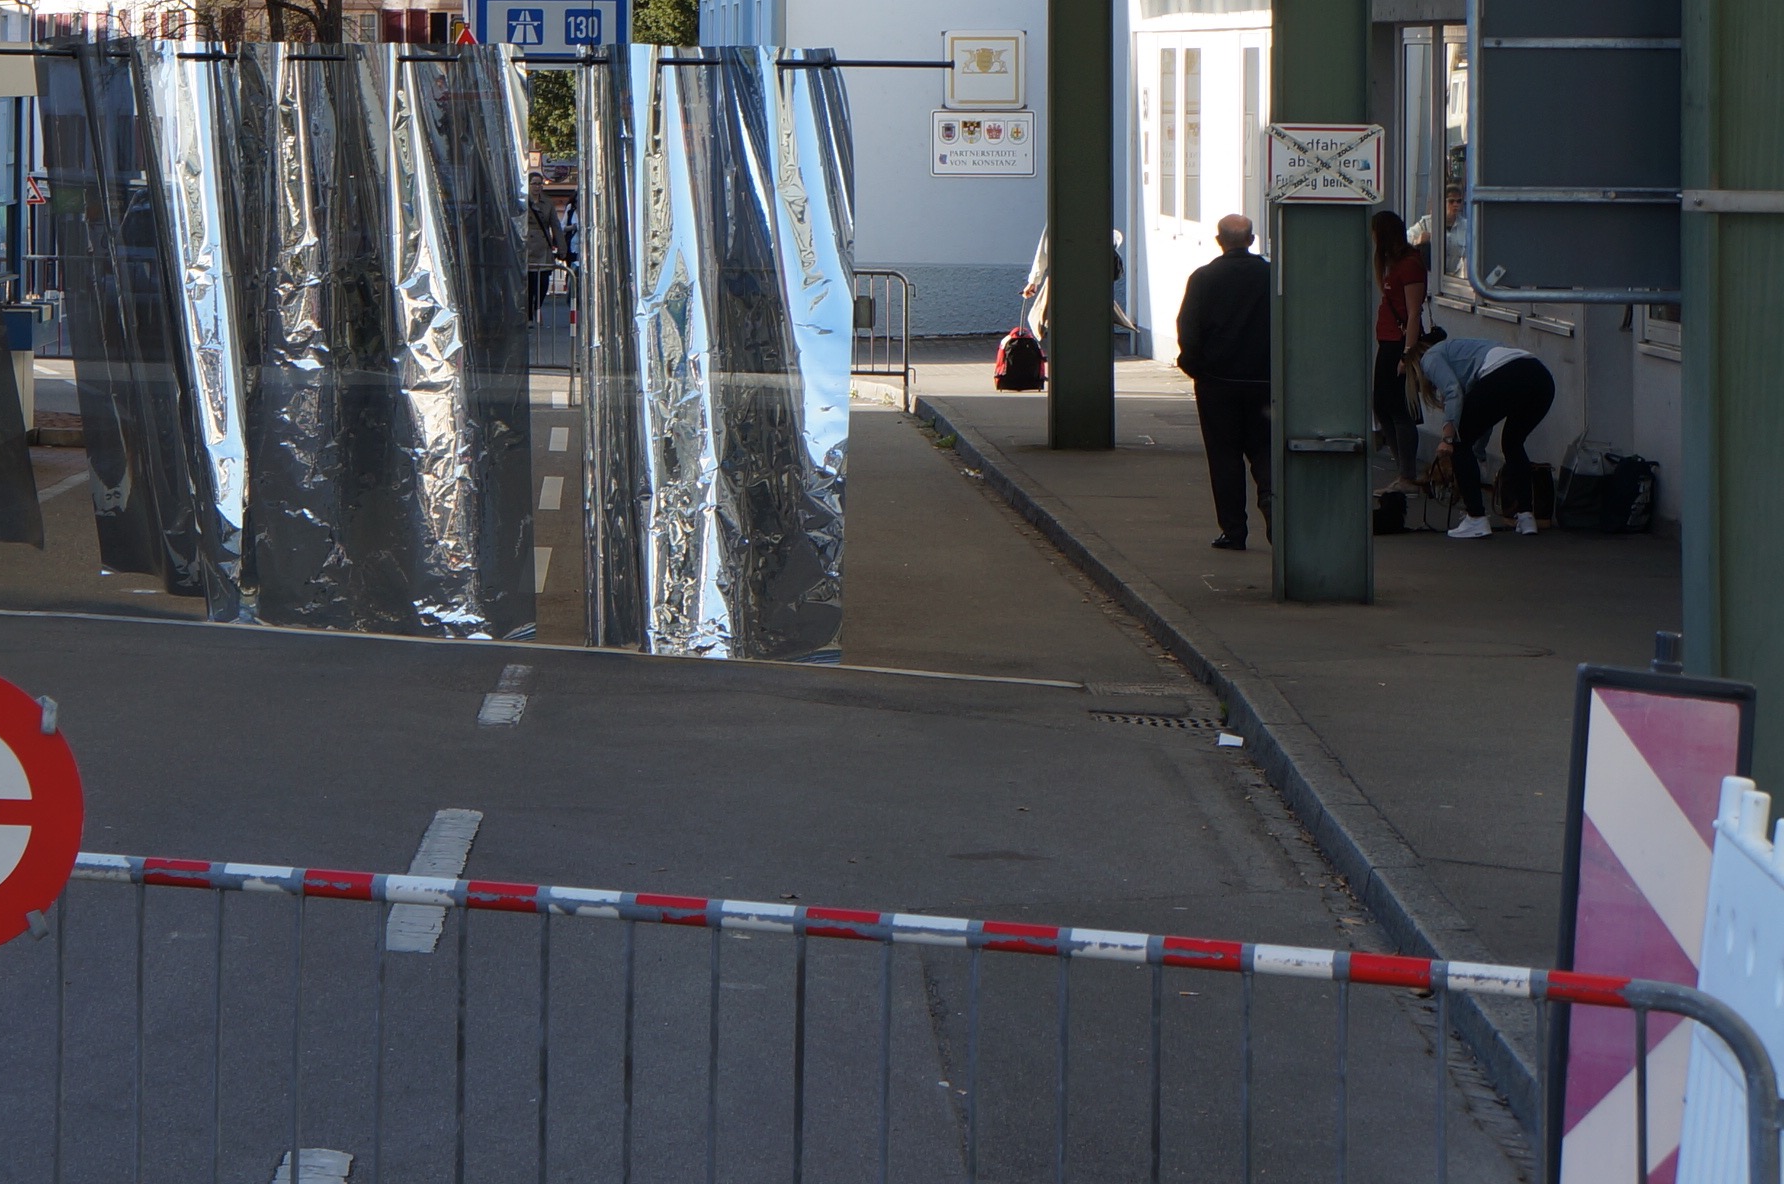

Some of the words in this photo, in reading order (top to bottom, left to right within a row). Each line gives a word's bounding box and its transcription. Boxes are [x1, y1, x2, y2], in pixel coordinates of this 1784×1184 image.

[567, 16, 598, 39] 130
[1359, 130, 1376, 143] ZOLL
[1337, 145, 1354, 157] ZOLL
[949, 159, 967, 167] VON
[972, 159, 1017, 167] KONSTANZ
